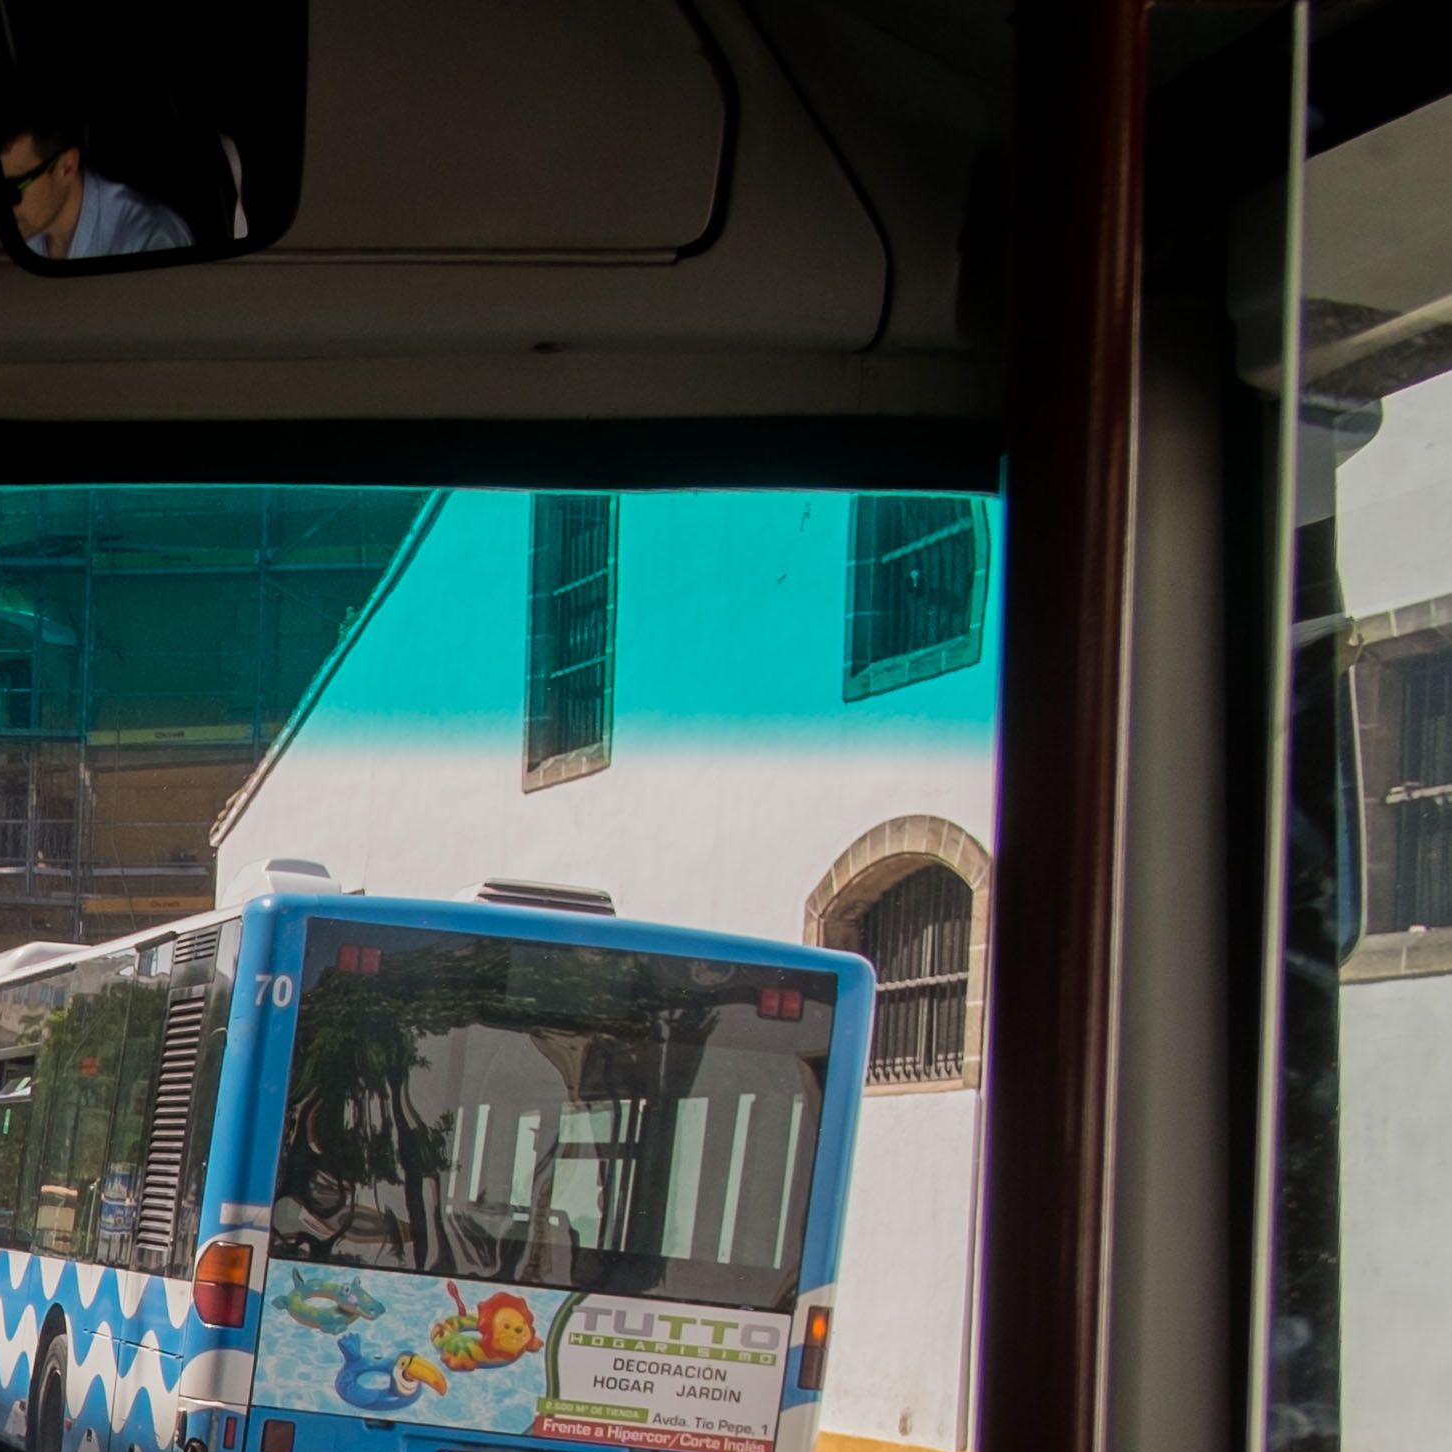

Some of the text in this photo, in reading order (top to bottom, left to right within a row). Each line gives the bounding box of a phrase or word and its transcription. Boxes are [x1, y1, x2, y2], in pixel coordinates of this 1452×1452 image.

[254, 973, 293, 1008] 70
[575, 1306, 781, 1351] TUTTO
[569, 1333, 776, 1364] HOGARISIMO
[613, 1356, 728, 1382] DECORACIÓN
[593, 1375, 742, 1403] HOGAR JARDÍN
[605, 1408, 640, 1419] TIENDA
[652, 1411, 690, 1428] Avda.
[760, 1423, 768, 1436] 1
[543, 1417, 592, 1437] Frente
[594, 1426, 604, 1438] a
[607, 1426, 722, 1451] Hipercor/Corte
